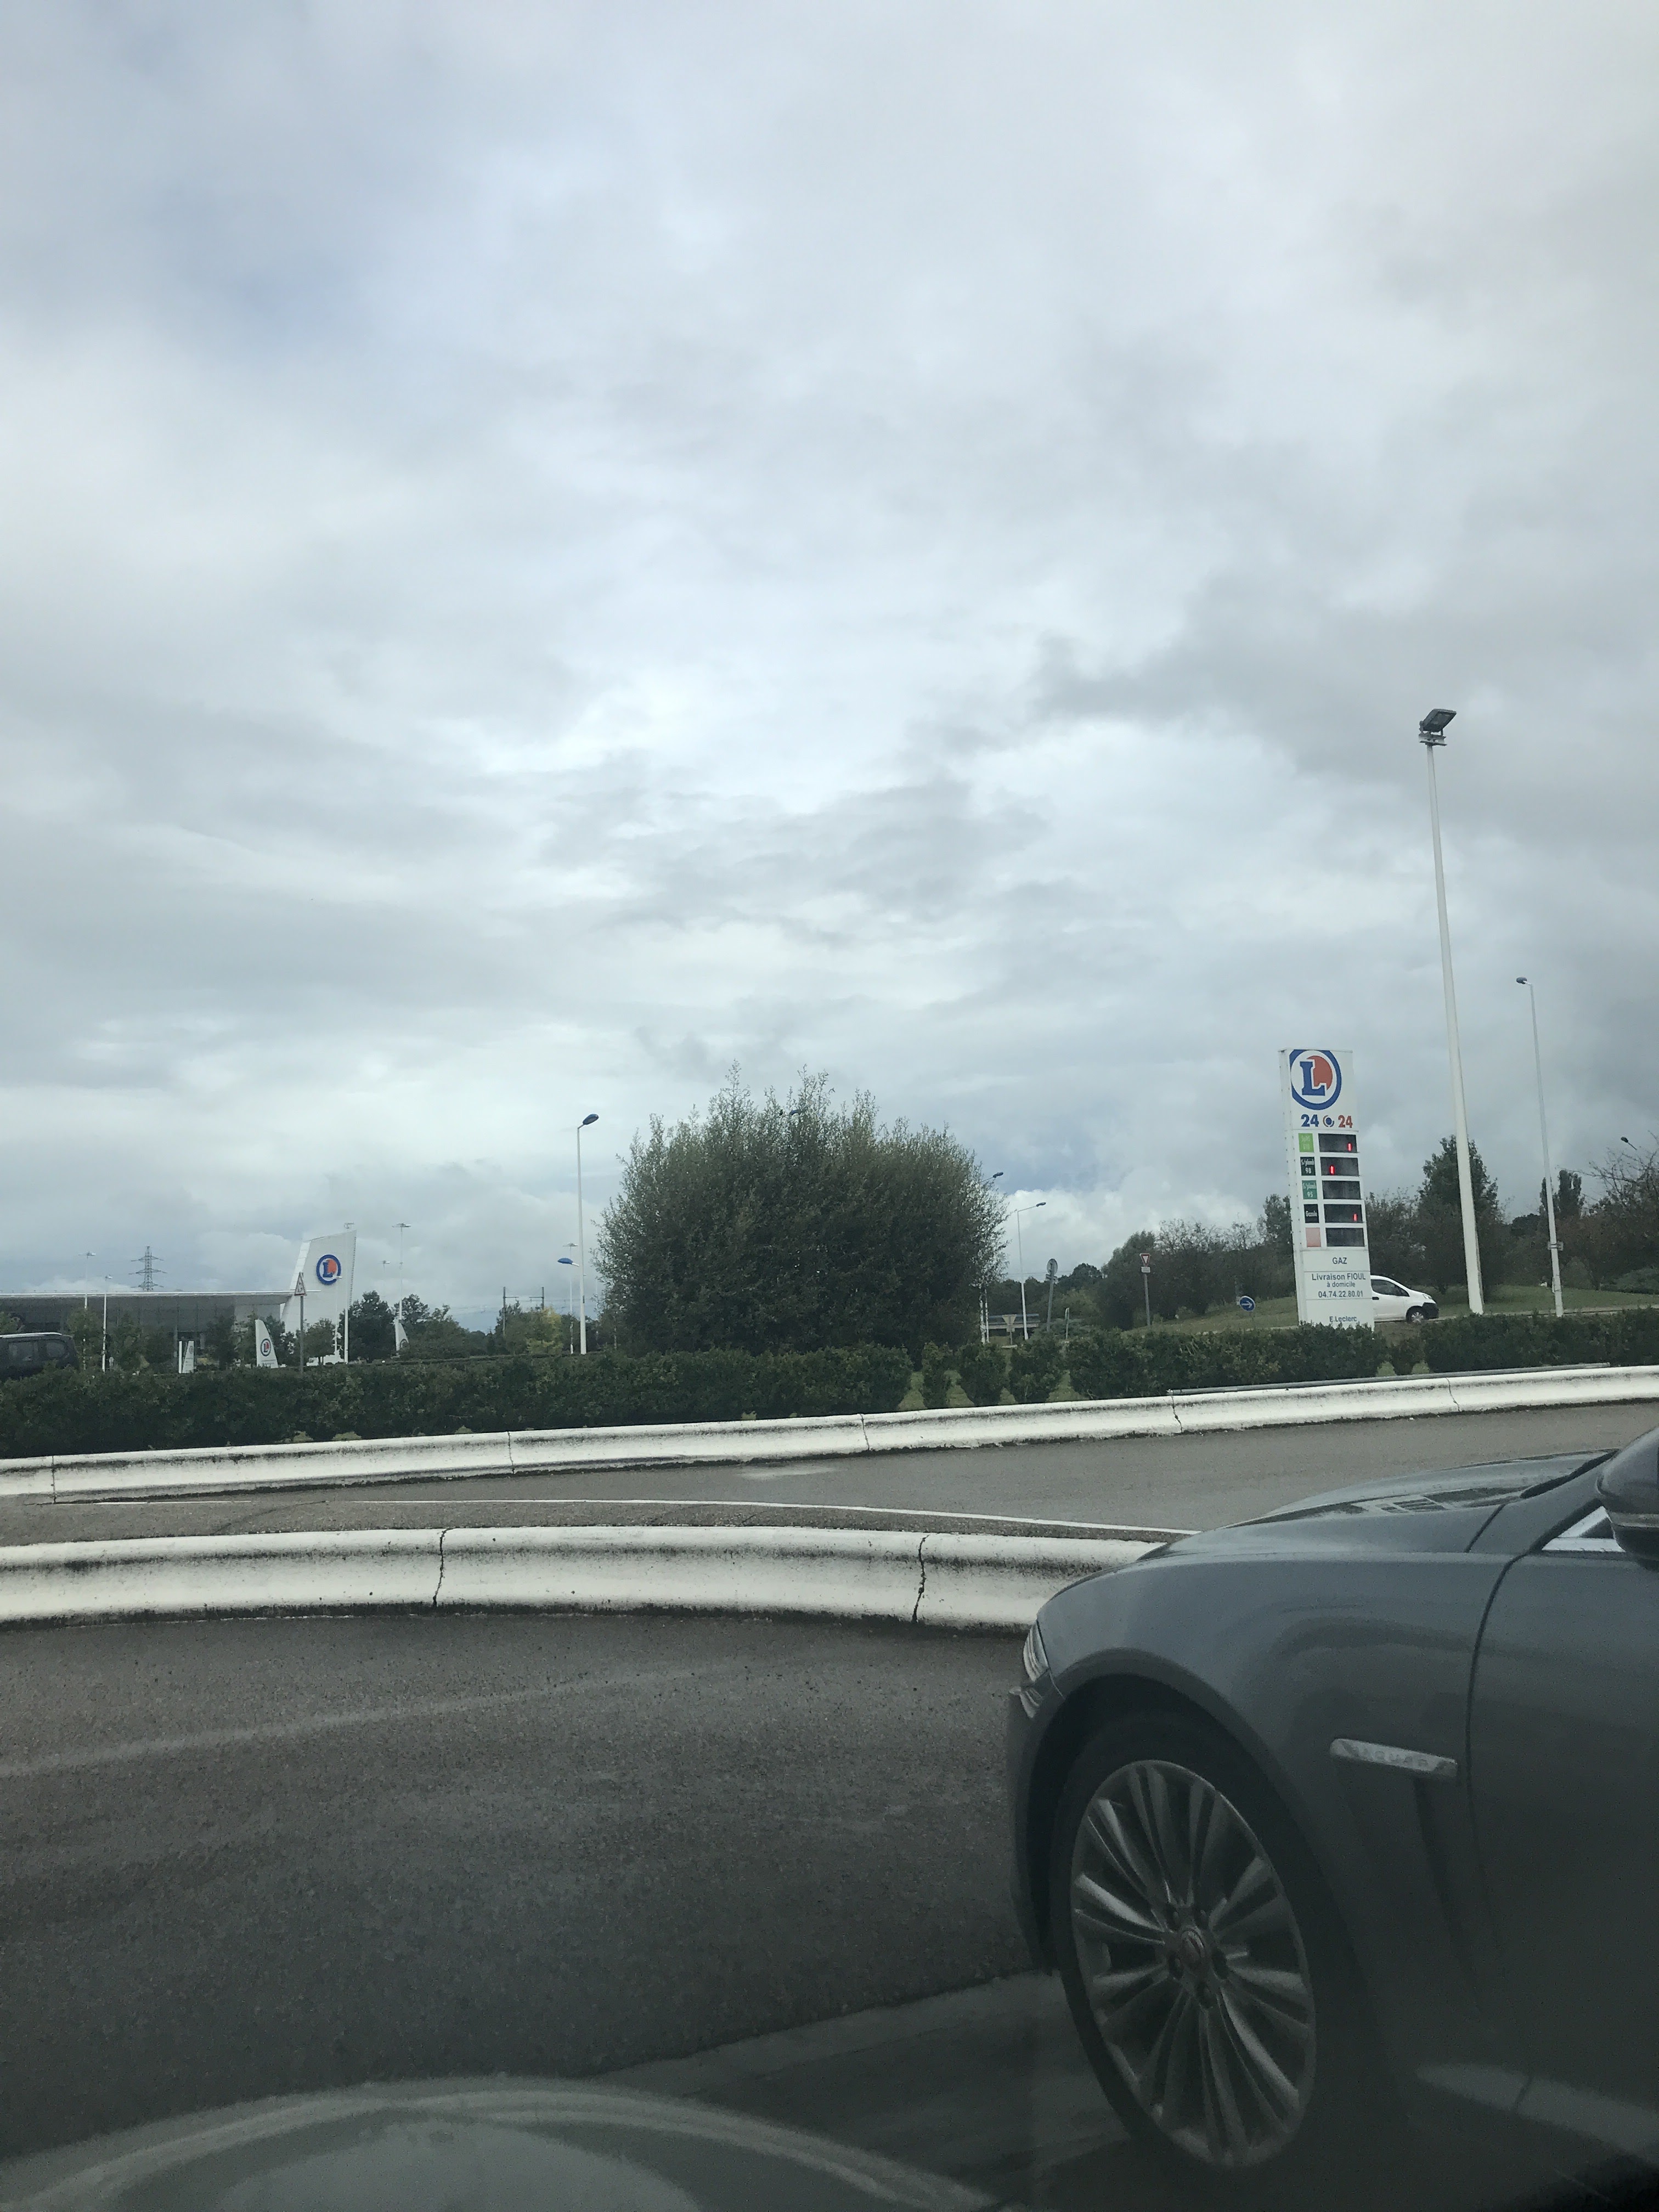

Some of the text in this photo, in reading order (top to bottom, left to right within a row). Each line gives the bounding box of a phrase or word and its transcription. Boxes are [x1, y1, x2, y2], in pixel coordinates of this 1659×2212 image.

[1300, 1061, 1325, 1097] L
[1300, 1114, 1353, 1128] 24 24
